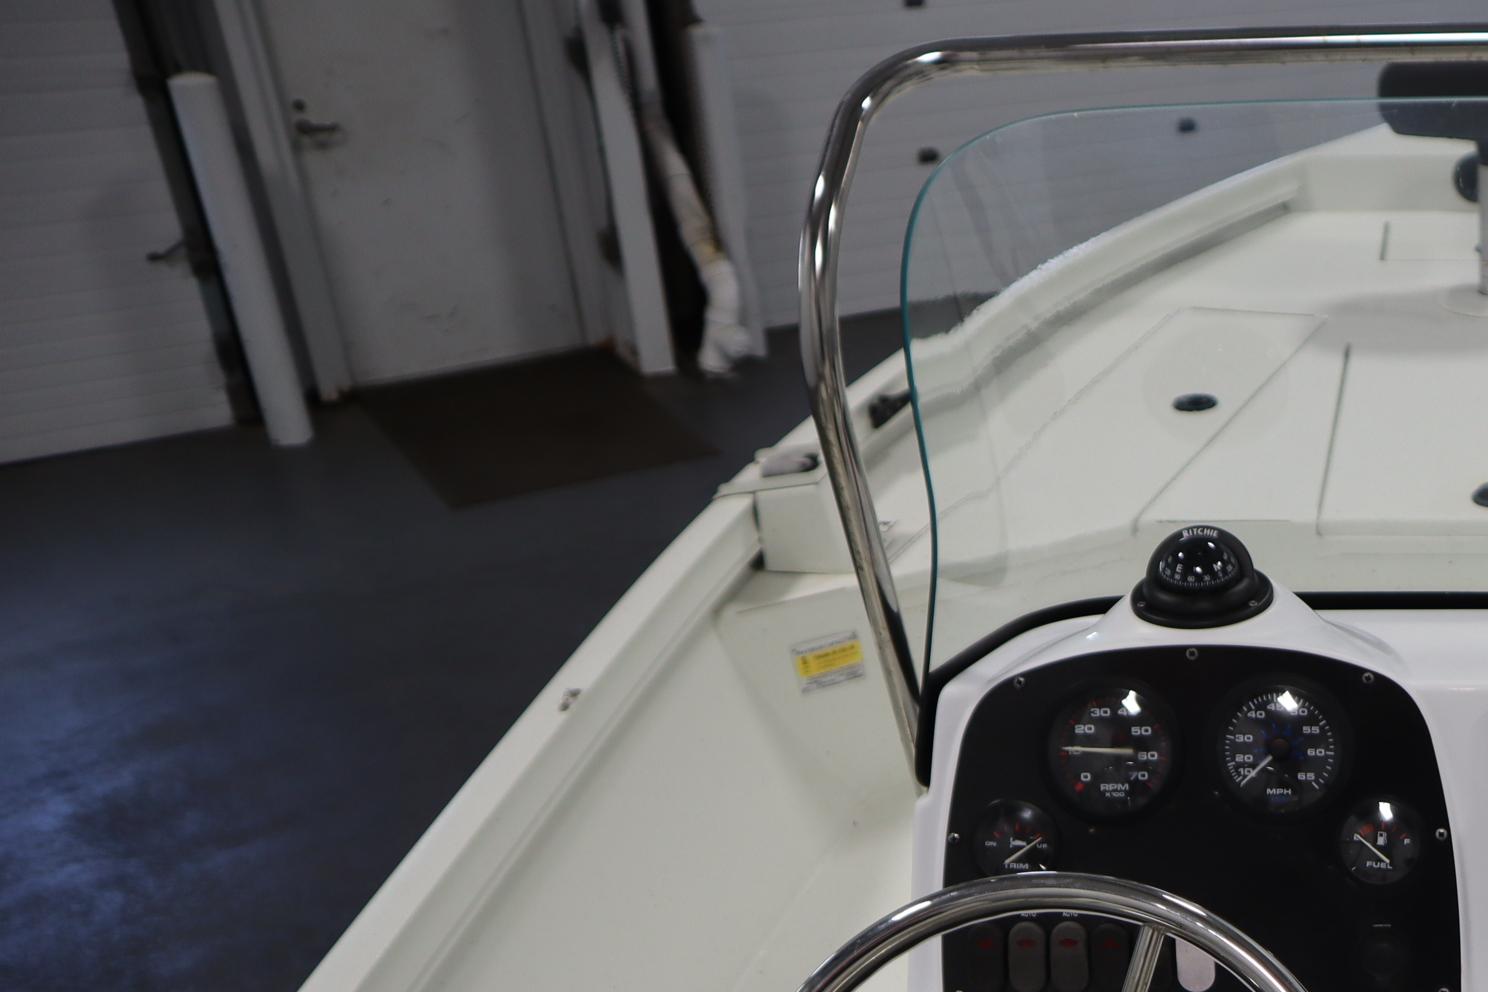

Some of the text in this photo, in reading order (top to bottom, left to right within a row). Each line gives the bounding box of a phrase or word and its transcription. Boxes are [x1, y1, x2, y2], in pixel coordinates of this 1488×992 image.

[1182, 527, 1219, 537] RITCHIE
[1090, 708, 1111, 717] 30
[1247, 710, 1266, 719] 40
[1074, 724, 1095, 734] 20
[1131, 726, 1152, 735] 50
[1302, 726, 1320, 734] 55
[1235, 734, 1253, 743] 30
[1137, 751, 1158, 760] 60
[1307, 748, 1325, 756] 60
[1235, 754, 1253, 762] 20
[1080, 772, 1091, 781] 0
[1128, 771, 1149, 780] 70
[1297, 772, 1315, 780] 65
[1100, 783, 1129, 791] RPM
